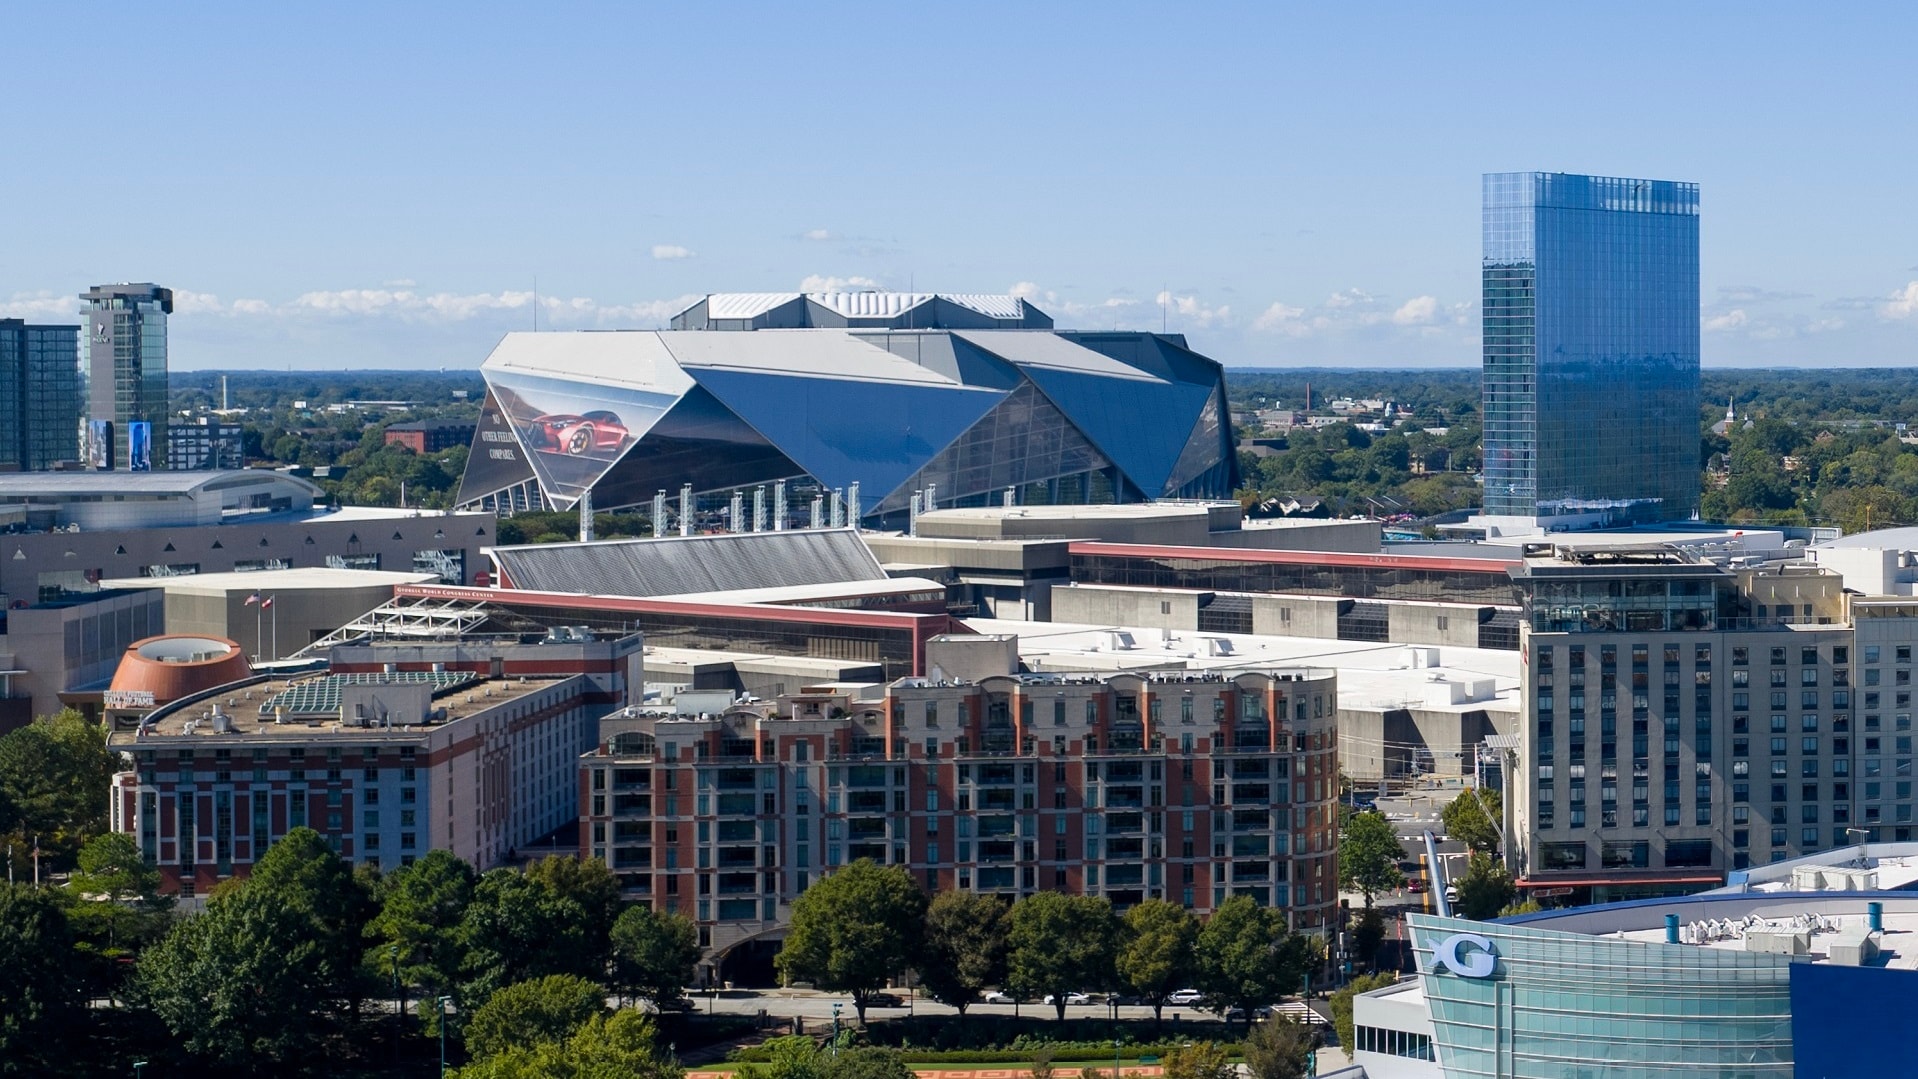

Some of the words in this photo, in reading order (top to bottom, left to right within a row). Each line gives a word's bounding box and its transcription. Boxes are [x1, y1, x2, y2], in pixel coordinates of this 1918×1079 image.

[492, 414, 500, 424] NO
[481, 431, 498, 442] OTHER
[104, 696, 122, 705] HALL
[123, 697, 133, 705] OF
[134, 697, 154, 705] FAME
